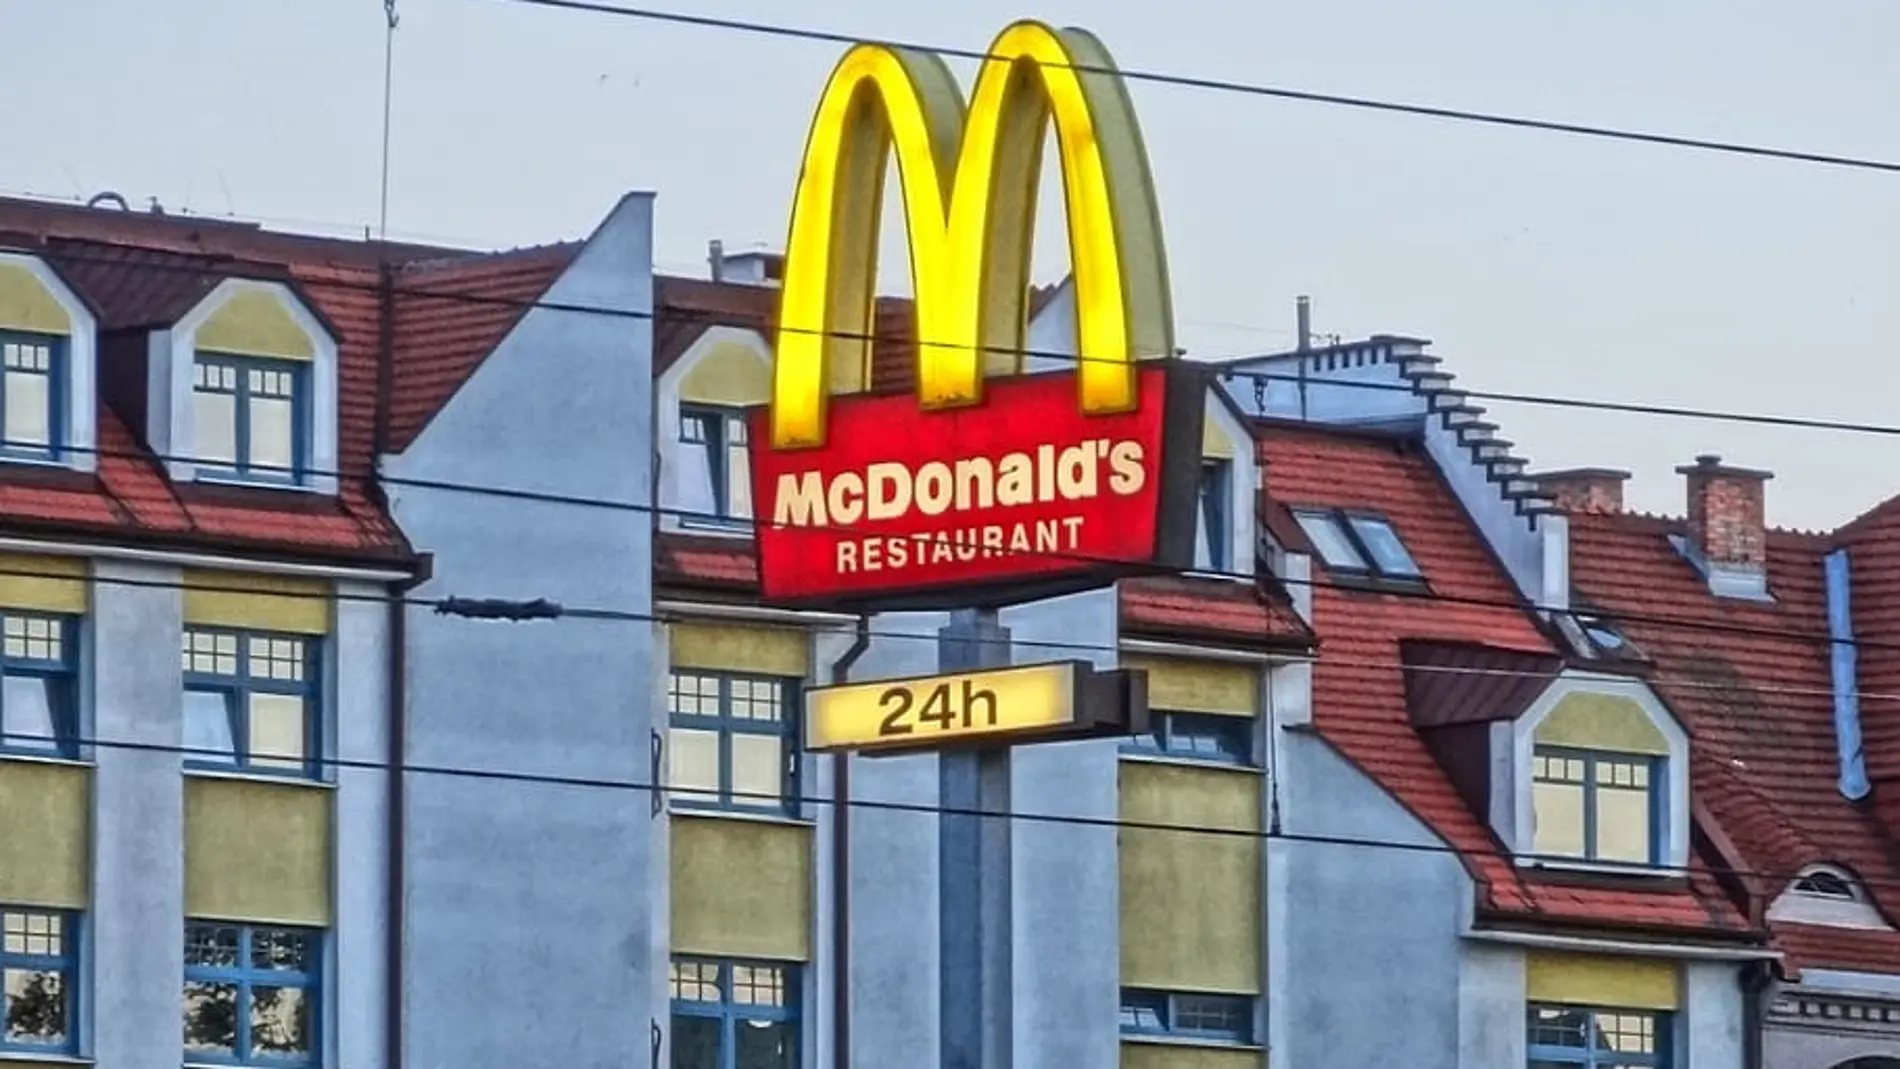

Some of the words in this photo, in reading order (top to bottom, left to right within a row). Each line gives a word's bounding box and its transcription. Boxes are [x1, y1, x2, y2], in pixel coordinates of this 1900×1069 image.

[771, 19, 1138, 449] M
[773, 439, 1145, 529] McDonald's
[837, 517, 1084, 573] RESTAURANT
[878, 680, 998, 737] 24h
